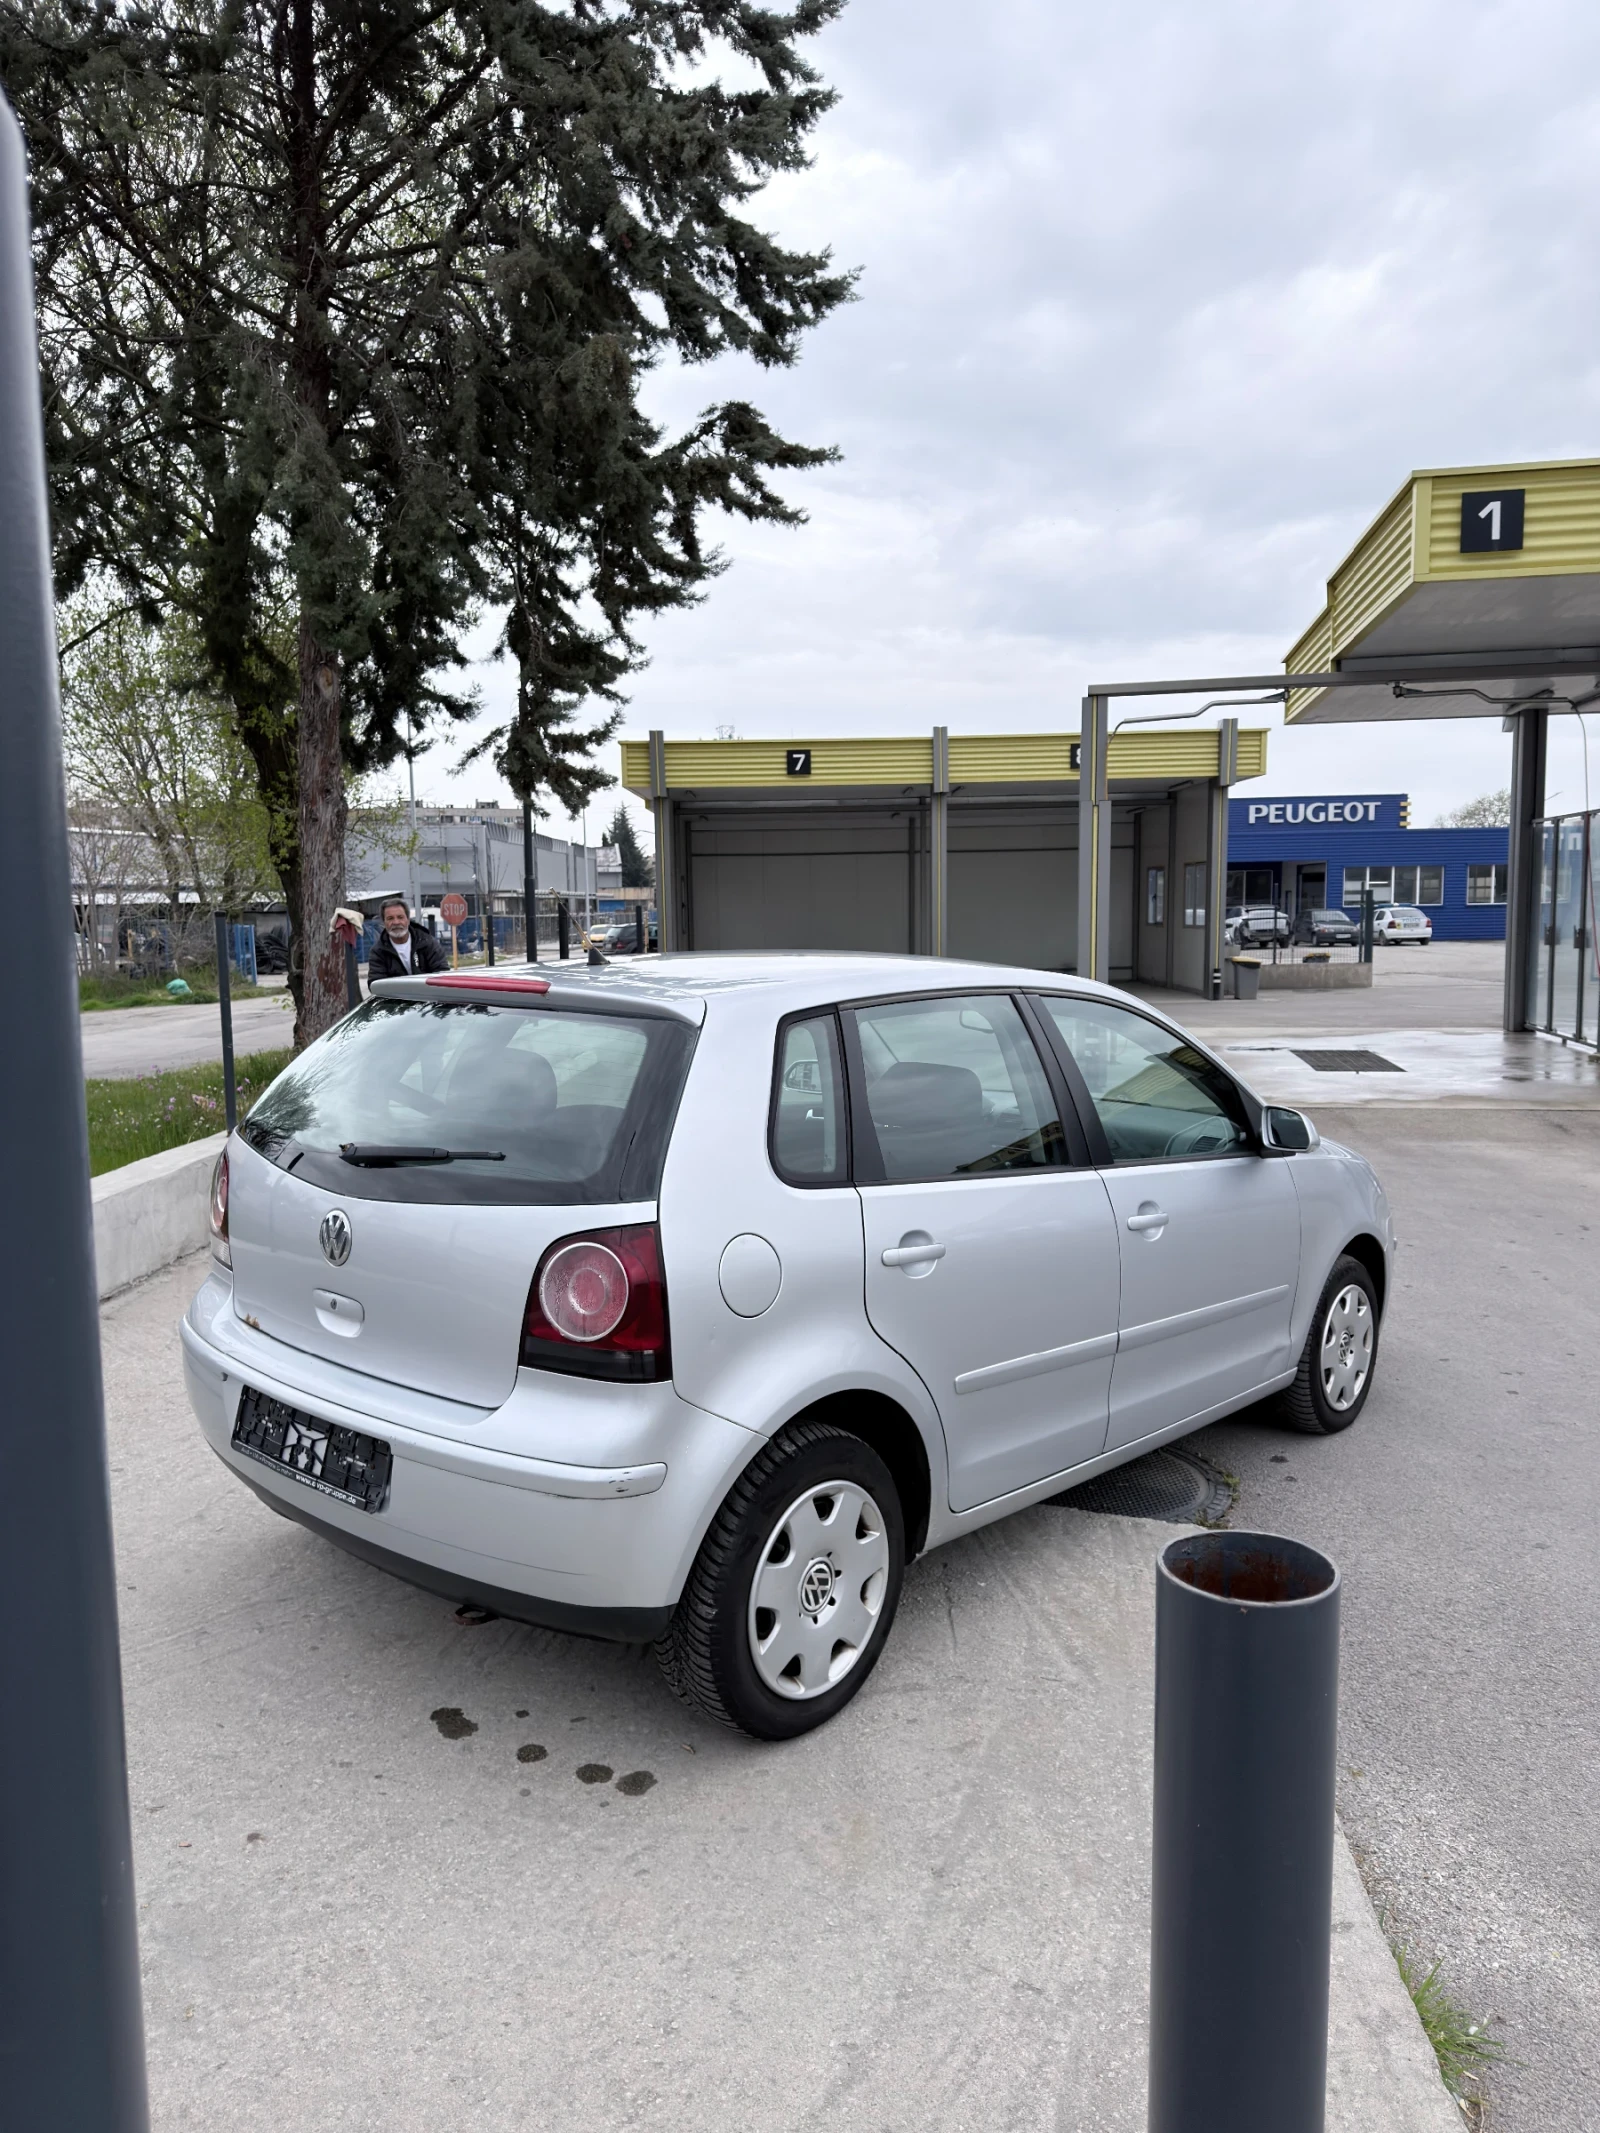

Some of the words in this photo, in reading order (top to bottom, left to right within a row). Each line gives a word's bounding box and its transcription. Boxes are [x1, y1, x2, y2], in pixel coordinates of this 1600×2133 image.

[1477, 500, 1502, 541] 1
[792, 753, 806, 771] 7
[1248, 801, 1382, 824] PEUGEOT
[443, 903, 465, 916] STOP
